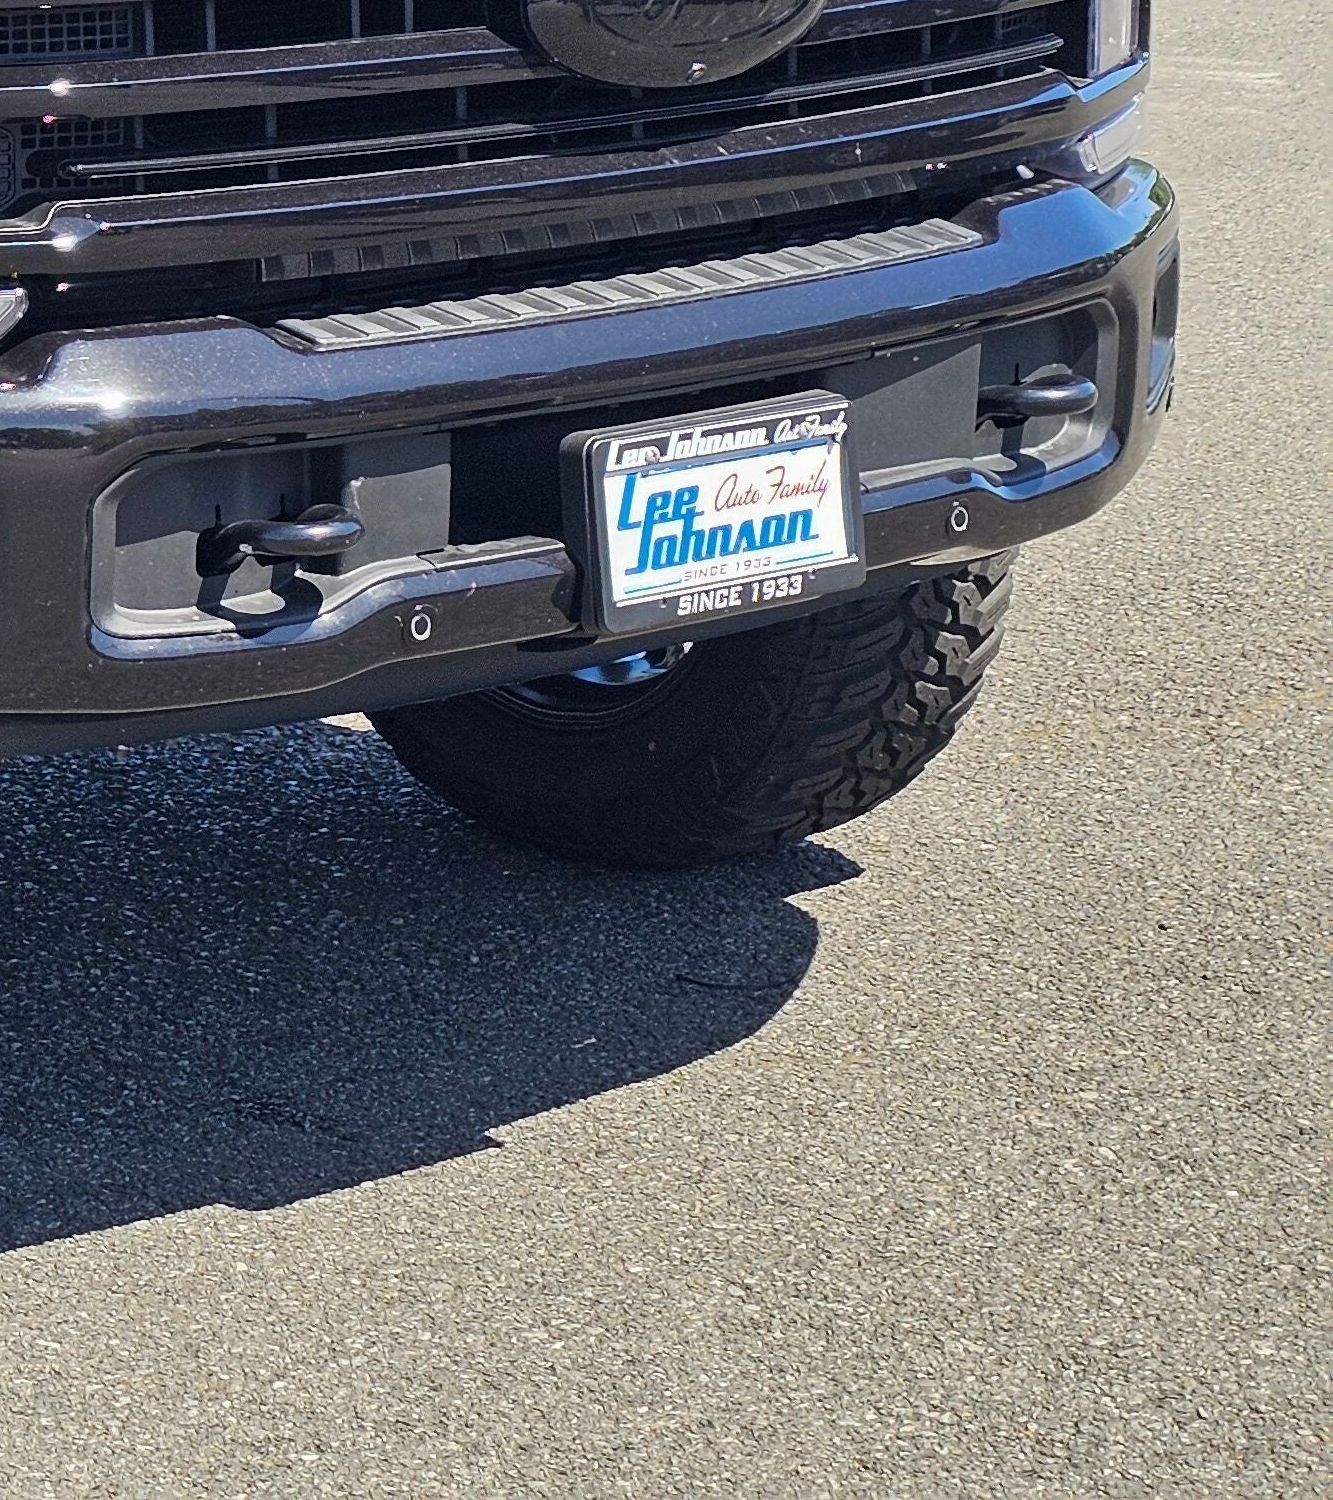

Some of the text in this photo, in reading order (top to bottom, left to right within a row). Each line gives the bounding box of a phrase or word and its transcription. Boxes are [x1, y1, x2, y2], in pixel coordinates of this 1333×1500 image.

[660, 426, 769, 465] Johnson
[617, 472, 700, 531] Lee
[715, 458, 832, 512] Auto Family
[624, 500, 820, 576] Johnson
[676, 574, 804, 616] SINCE 1933
[683, 564, 729, 582] SINCE
